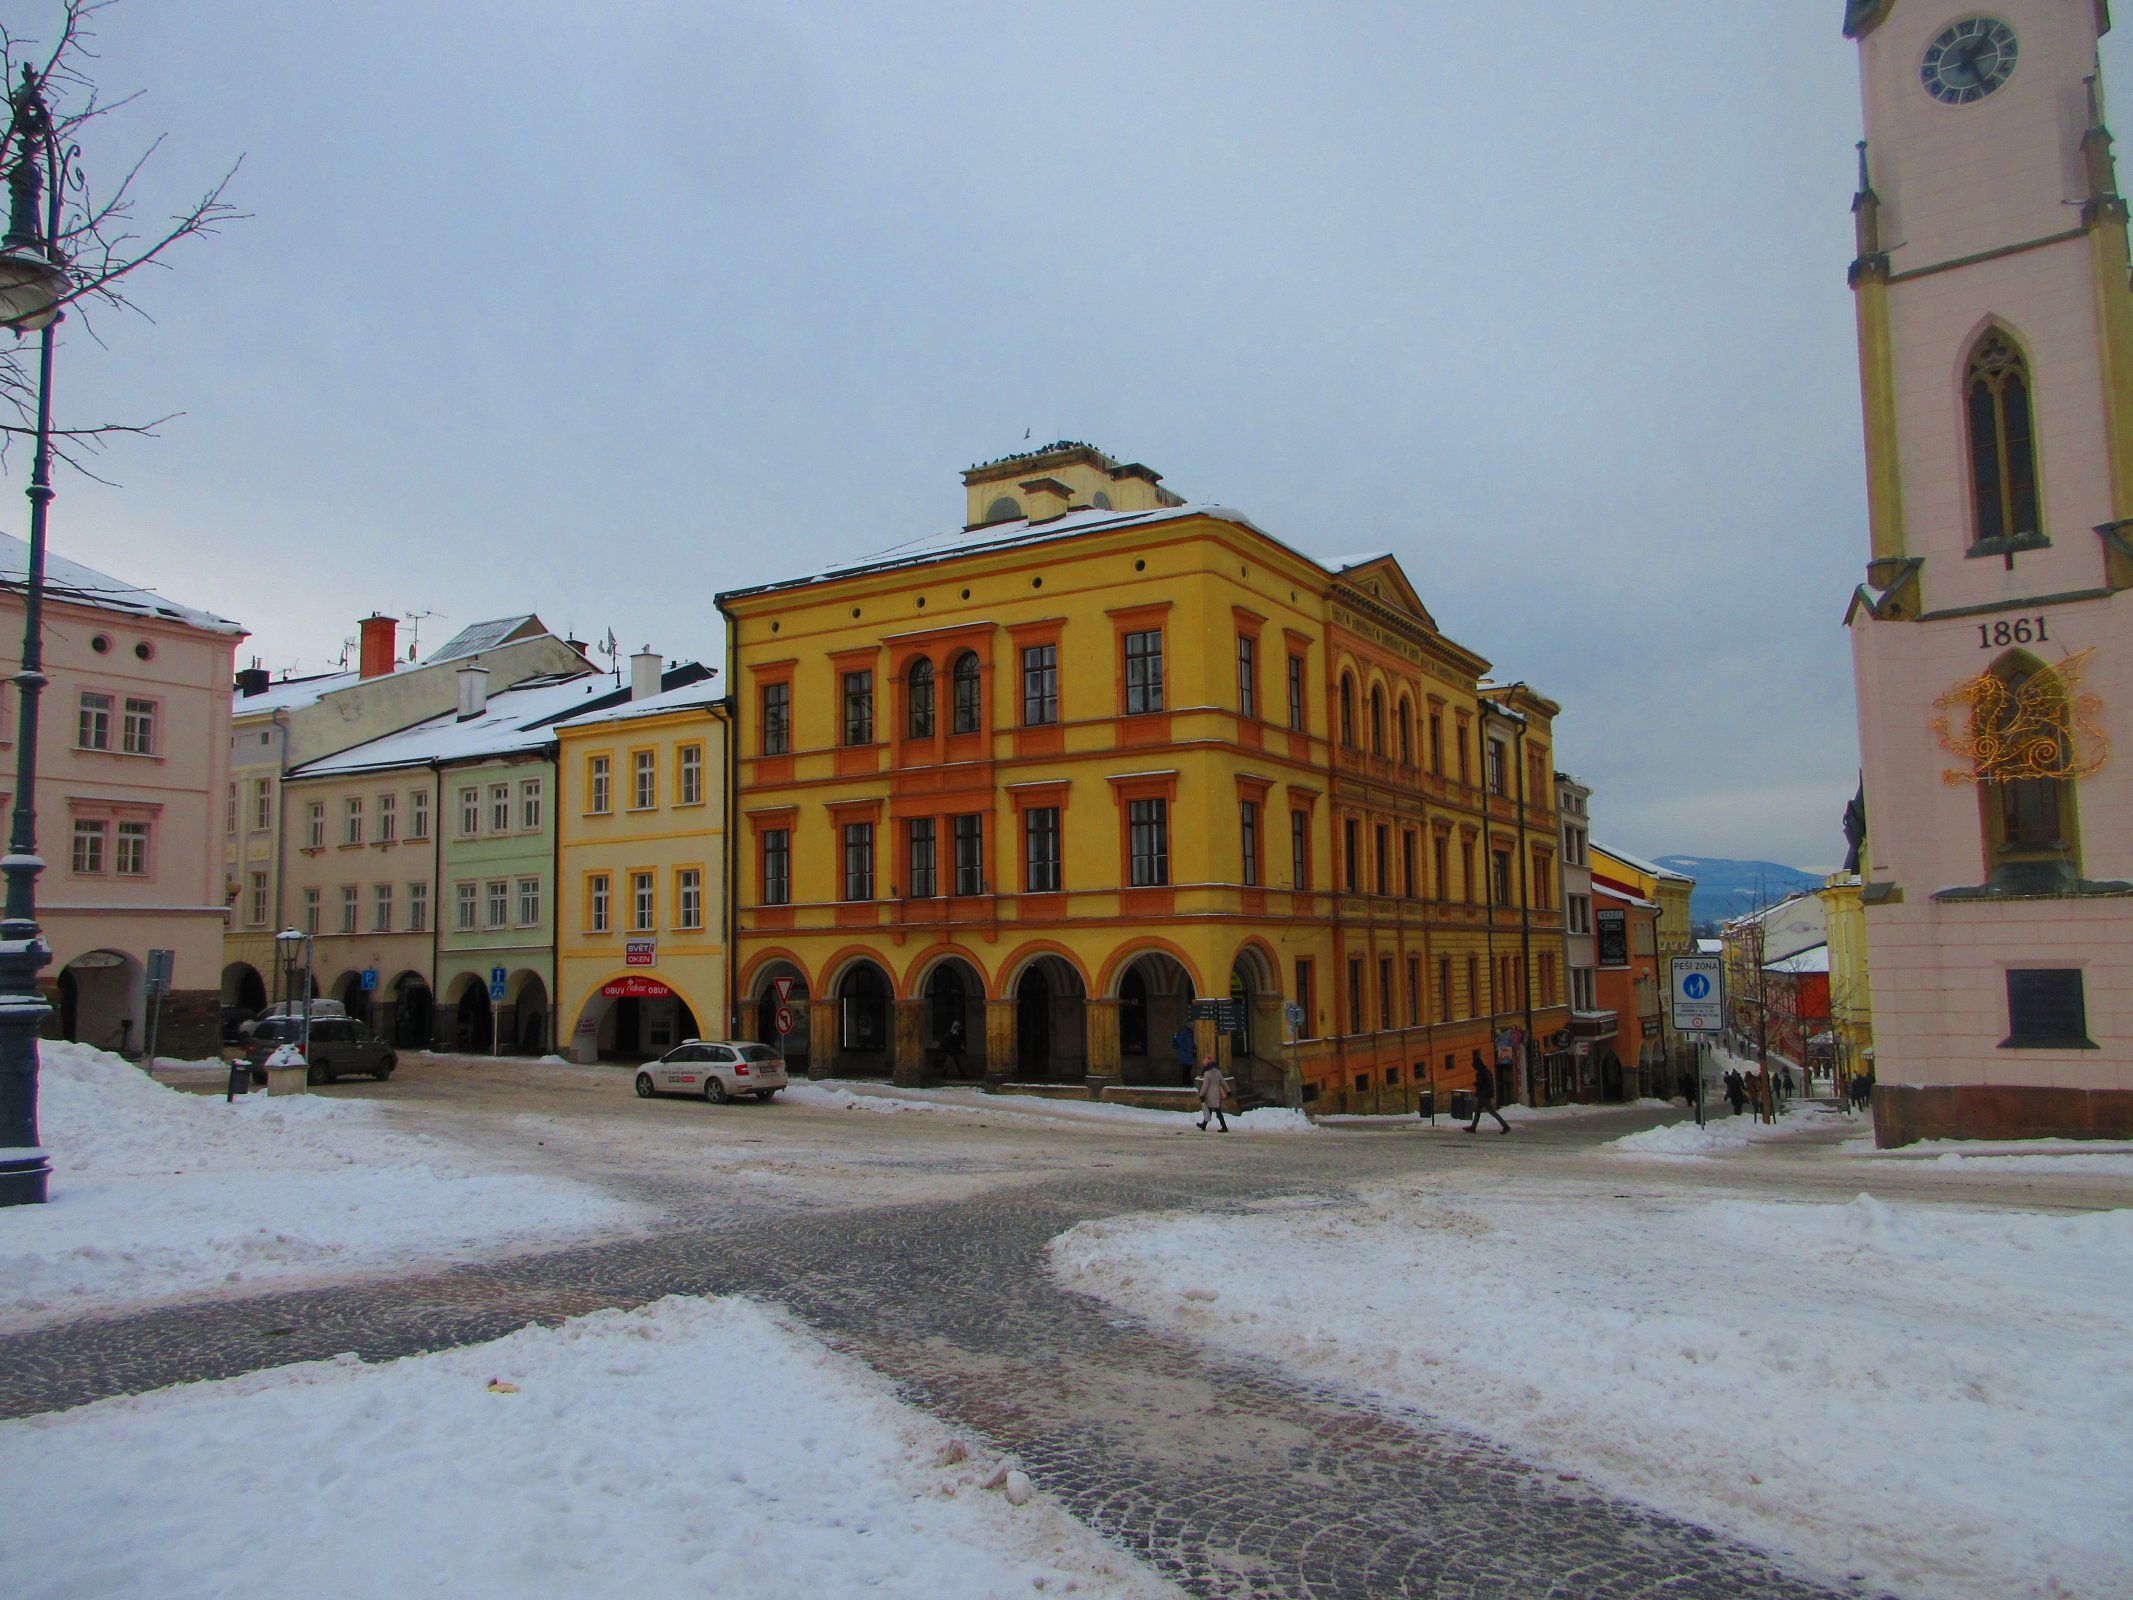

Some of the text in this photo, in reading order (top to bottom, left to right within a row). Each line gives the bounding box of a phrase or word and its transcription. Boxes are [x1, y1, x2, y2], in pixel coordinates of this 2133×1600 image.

[1978, 616, 2049, 649] 1861
[628, 955, 651, 963] OKEN
[605, 987, 625, 995] OBUV
[648, 986, 668, 994] OBUV
